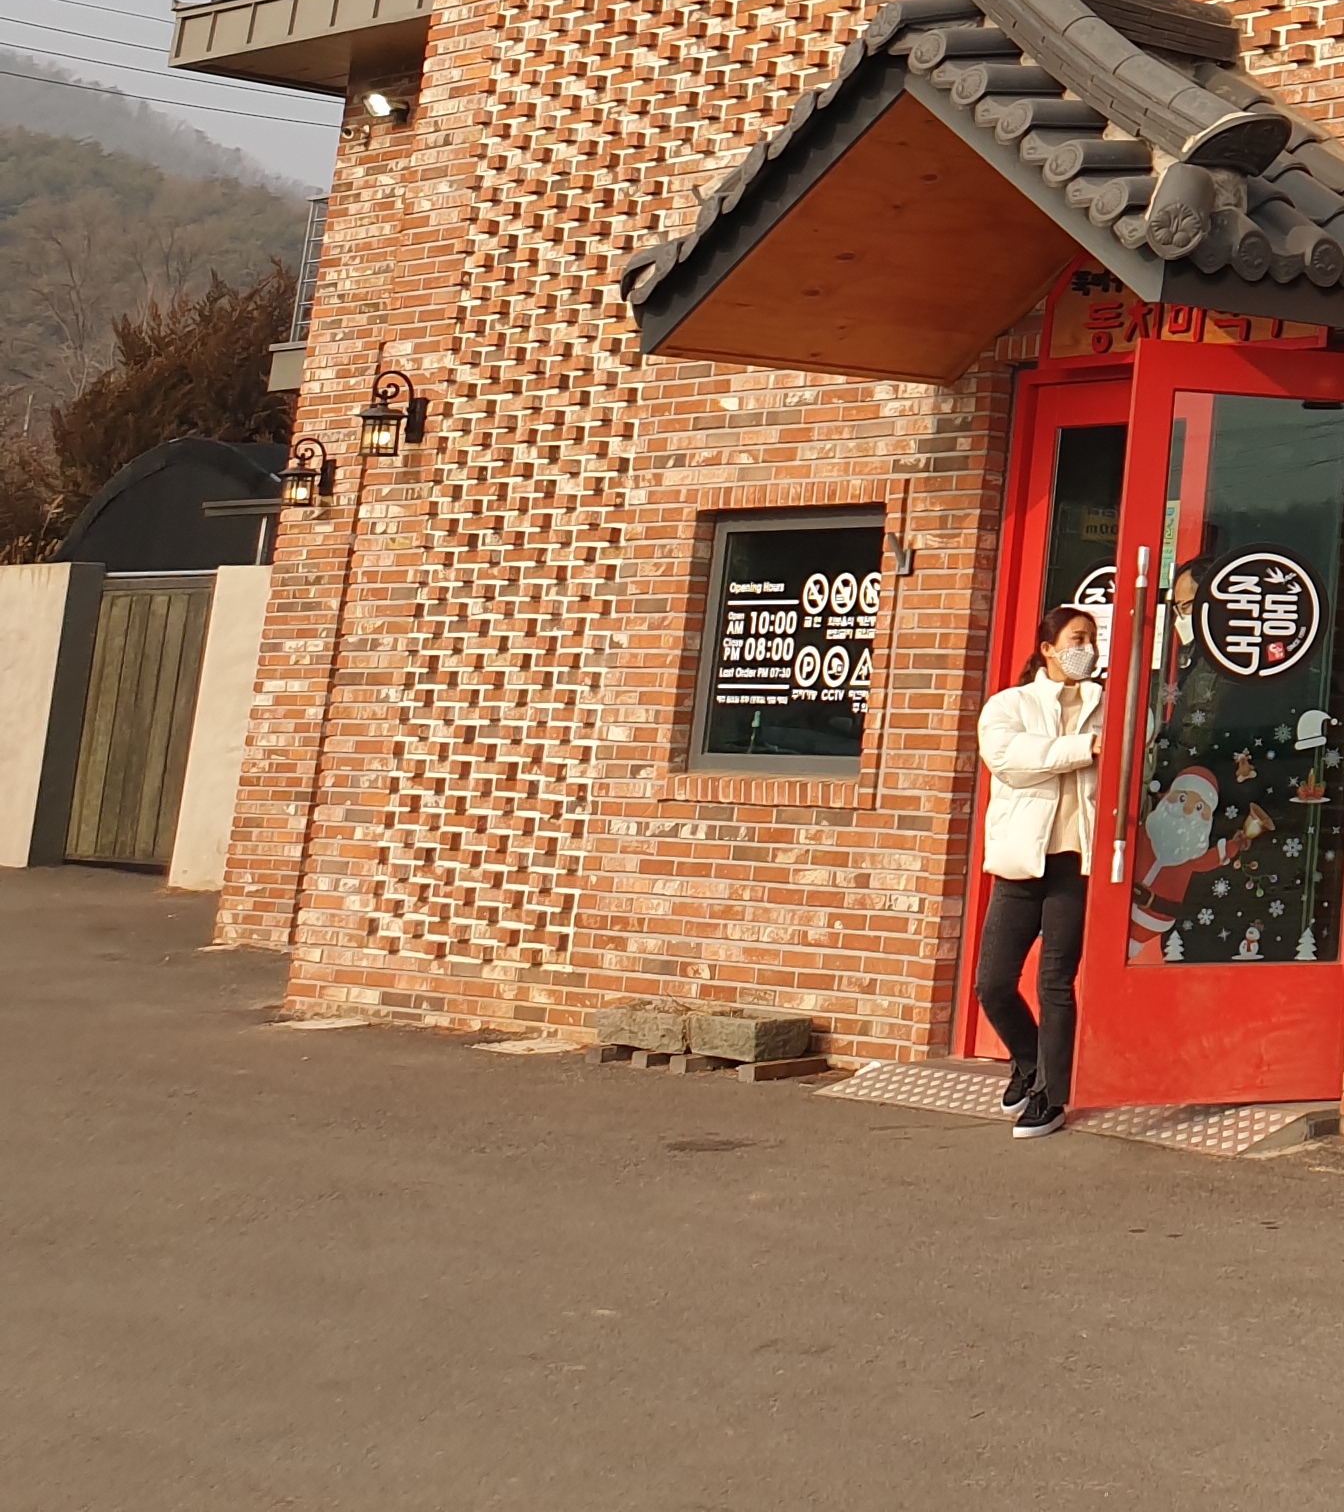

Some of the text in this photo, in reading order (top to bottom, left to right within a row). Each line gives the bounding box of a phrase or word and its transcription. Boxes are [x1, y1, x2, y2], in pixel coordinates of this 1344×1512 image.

[729, 581, 785, 594] Opening Hours
[726, 610, 798, 635] AM 10:00
[723, 637, 795, 661] PM 08:00
[719, 667, 735, 678] Last
[735, 667, 757, 678] Order
[757, 667, 769, 678] PM
[820, 689, 845, 701] CCTV
